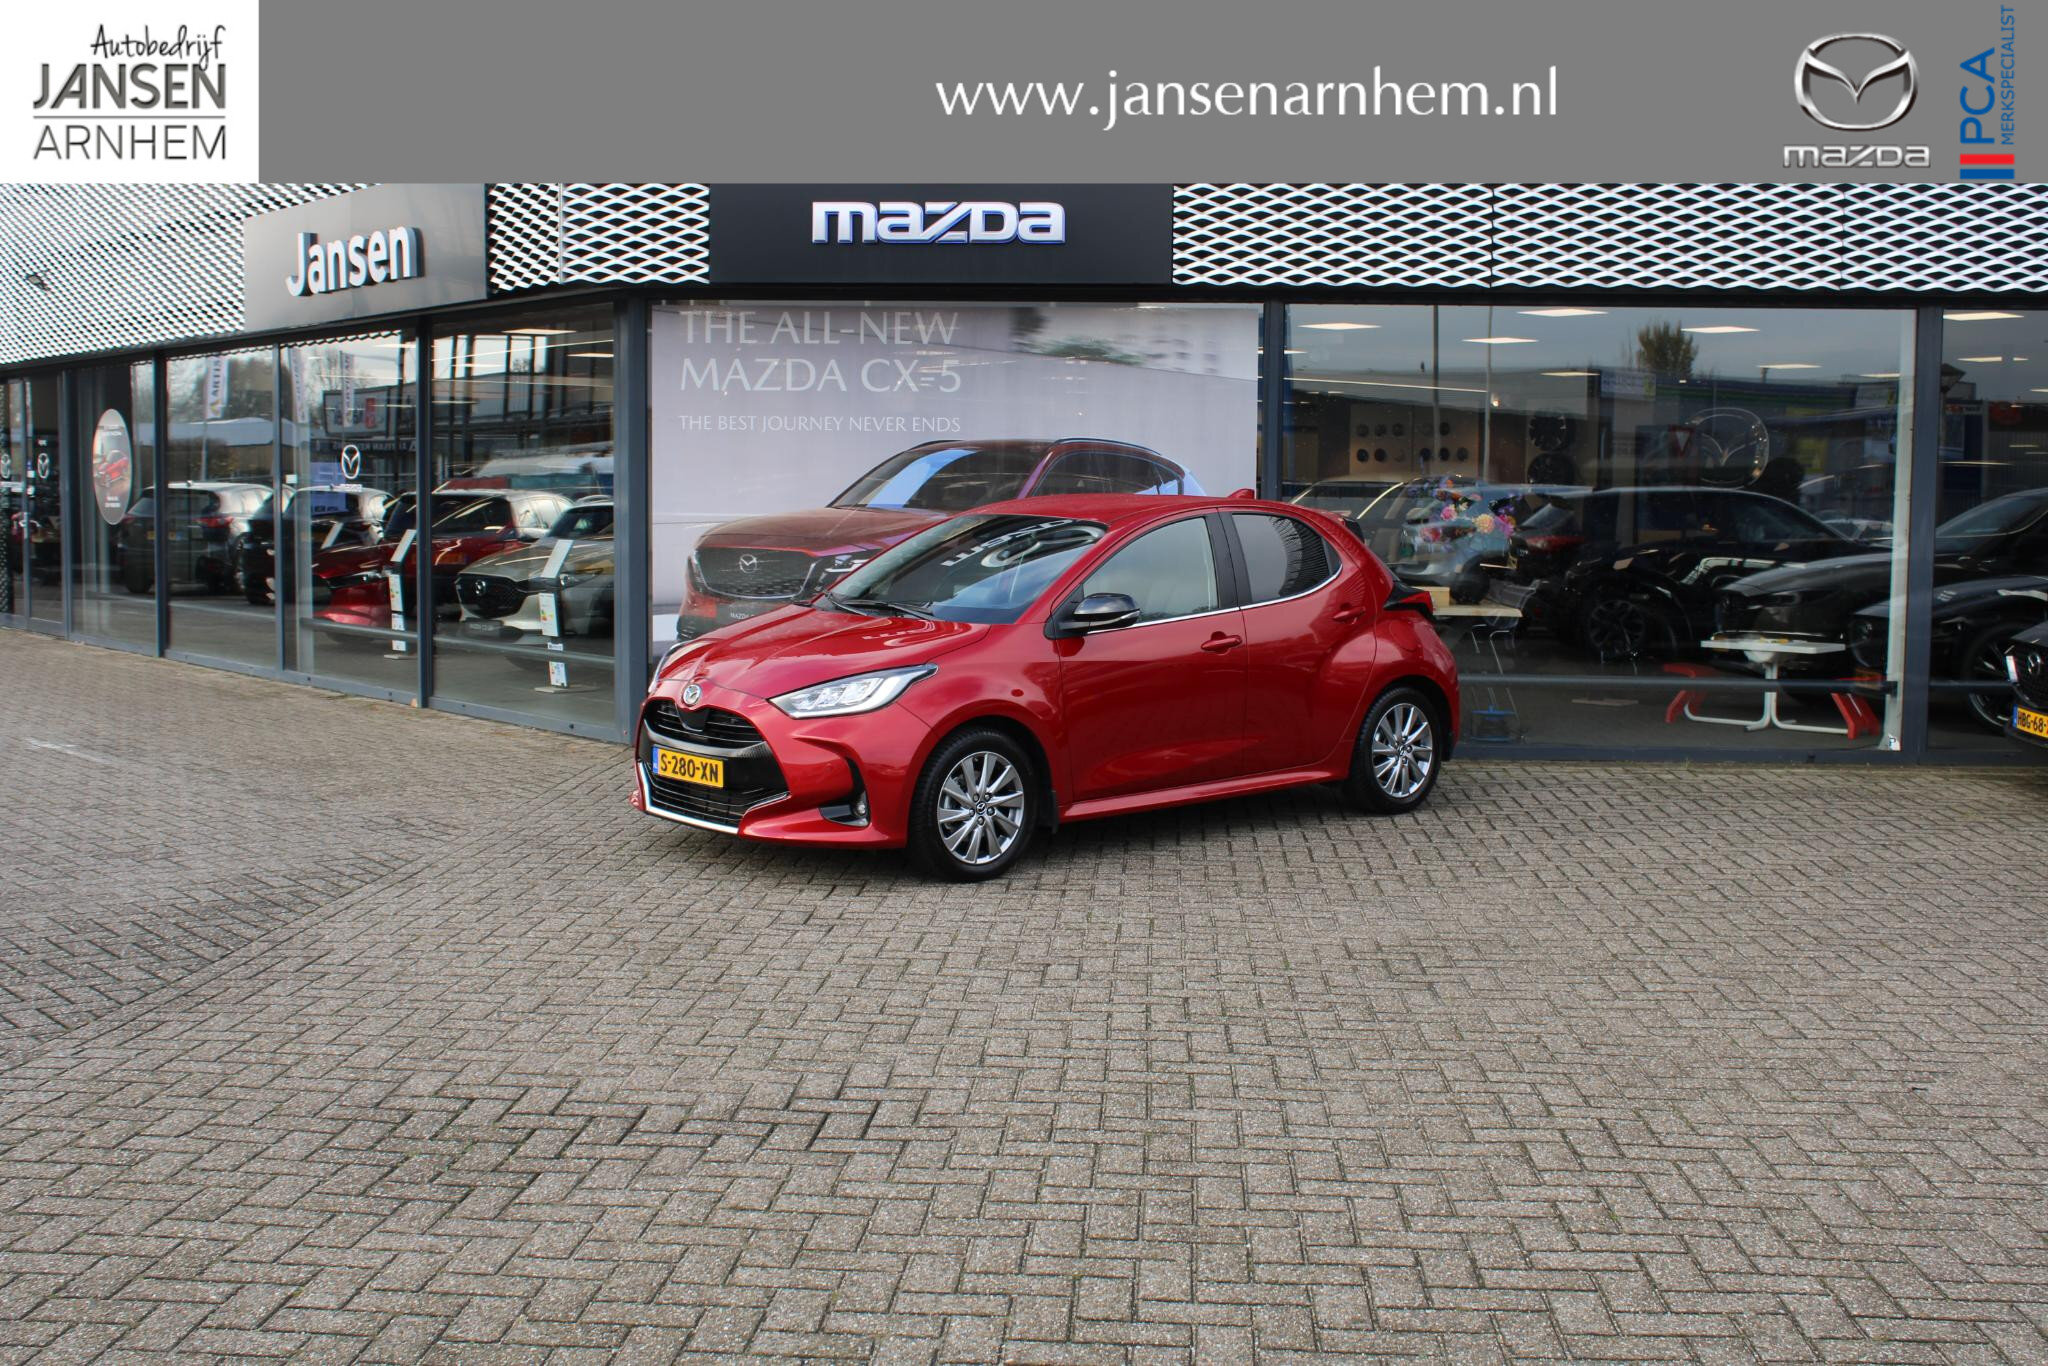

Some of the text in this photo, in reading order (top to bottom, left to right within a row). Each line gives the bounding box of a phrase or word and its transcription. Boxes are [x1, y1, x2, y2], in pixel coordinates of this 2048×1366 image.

[811, 201, 1066, 244] mazda
[285, 226, 418, 297] Jansen
[680, 311, 959, 345] THE ALL-NEW
[680, 358, 961, 393] MAZDA CX-5
[680, 415, 961, 433] THE BEST JOURNEY NEVER ENDS
[2017, 712, 2048, 735] HBG-68-
[661, 753, 719, 783] S-280-XN
